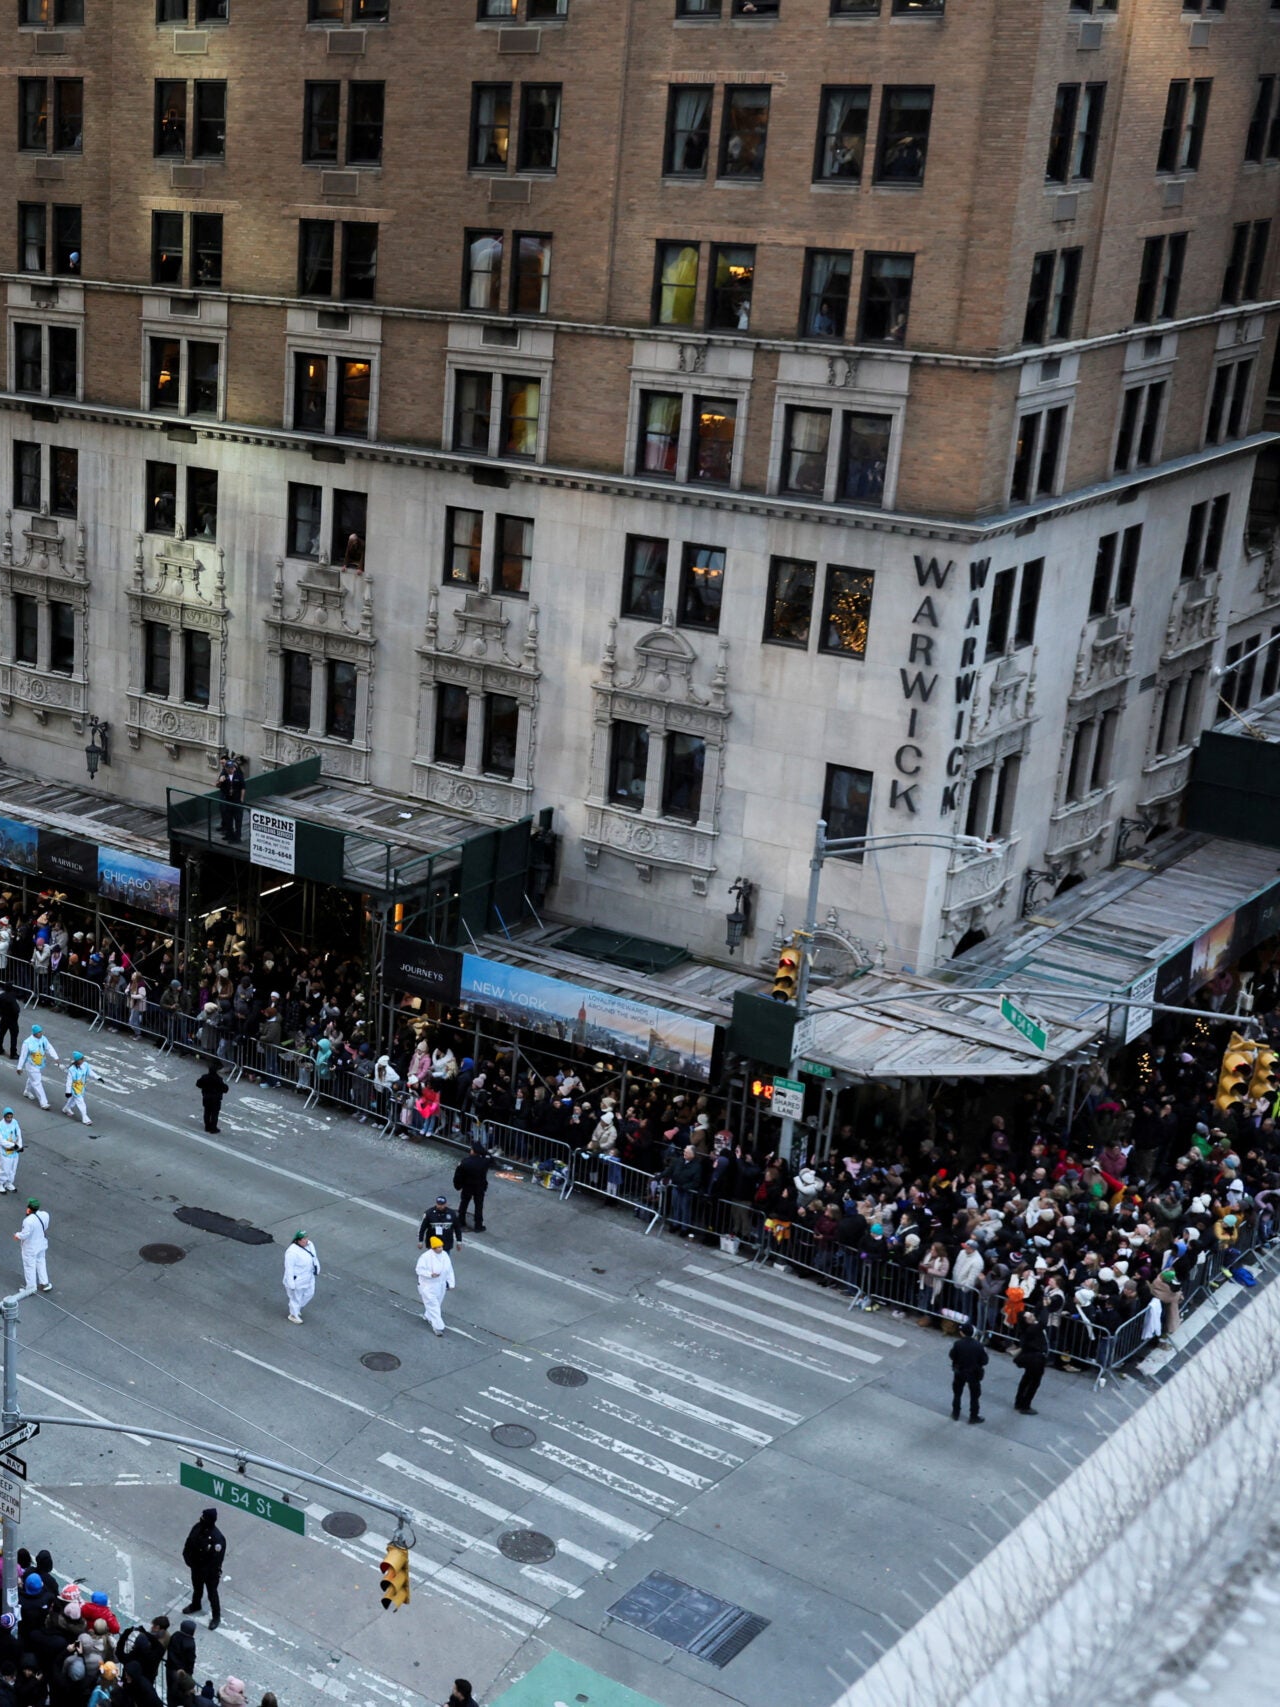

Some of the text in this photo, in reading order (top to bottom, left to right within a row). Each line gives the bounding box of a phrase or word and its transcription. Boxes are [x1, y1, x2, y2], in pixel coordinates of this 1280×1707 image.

[889, 555, 953, 813] WARWICK
[940, 557, 992, 816] WARWICK
[252, 813, 294, 832] CEPRINE
[51, 855, 84, 872] WARWICK
[103, 869, 152, 891] CHICAGO
[399, 963, 444, 982] JOURNEYS
[473, 980, 548, 1011] NEW YORK
[774, 1098, 800, 1110] SHARED
[777, 1106, 794, 1116] LANE
[0, 1437, 15, 1450] ONE
[19, 1425, 34, 1439] WAY
[6, 1457, 21, 1471] WAY
[212, 1478, 272, 1517] W 54 St
